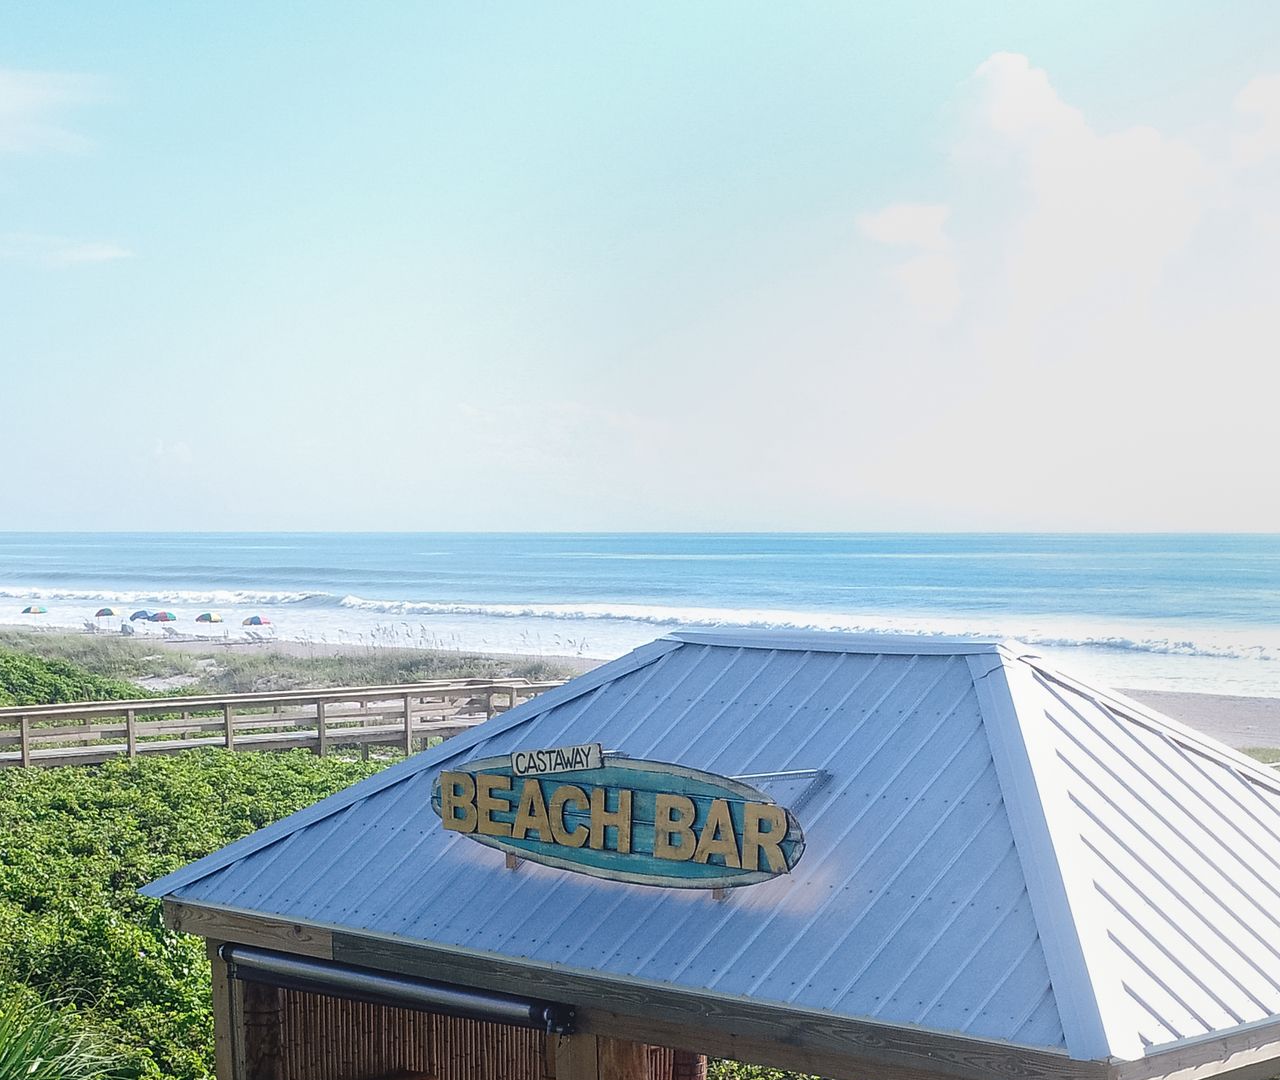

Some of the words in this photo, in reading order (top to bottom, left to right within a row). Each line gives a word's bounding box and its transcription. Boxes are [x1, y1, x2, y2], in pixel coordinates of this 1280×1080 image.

[516, 747, 591, 774] CASTAWAY
[440, 771, 631, 854] BEACH
[653, 793, 790, 874] BAR
